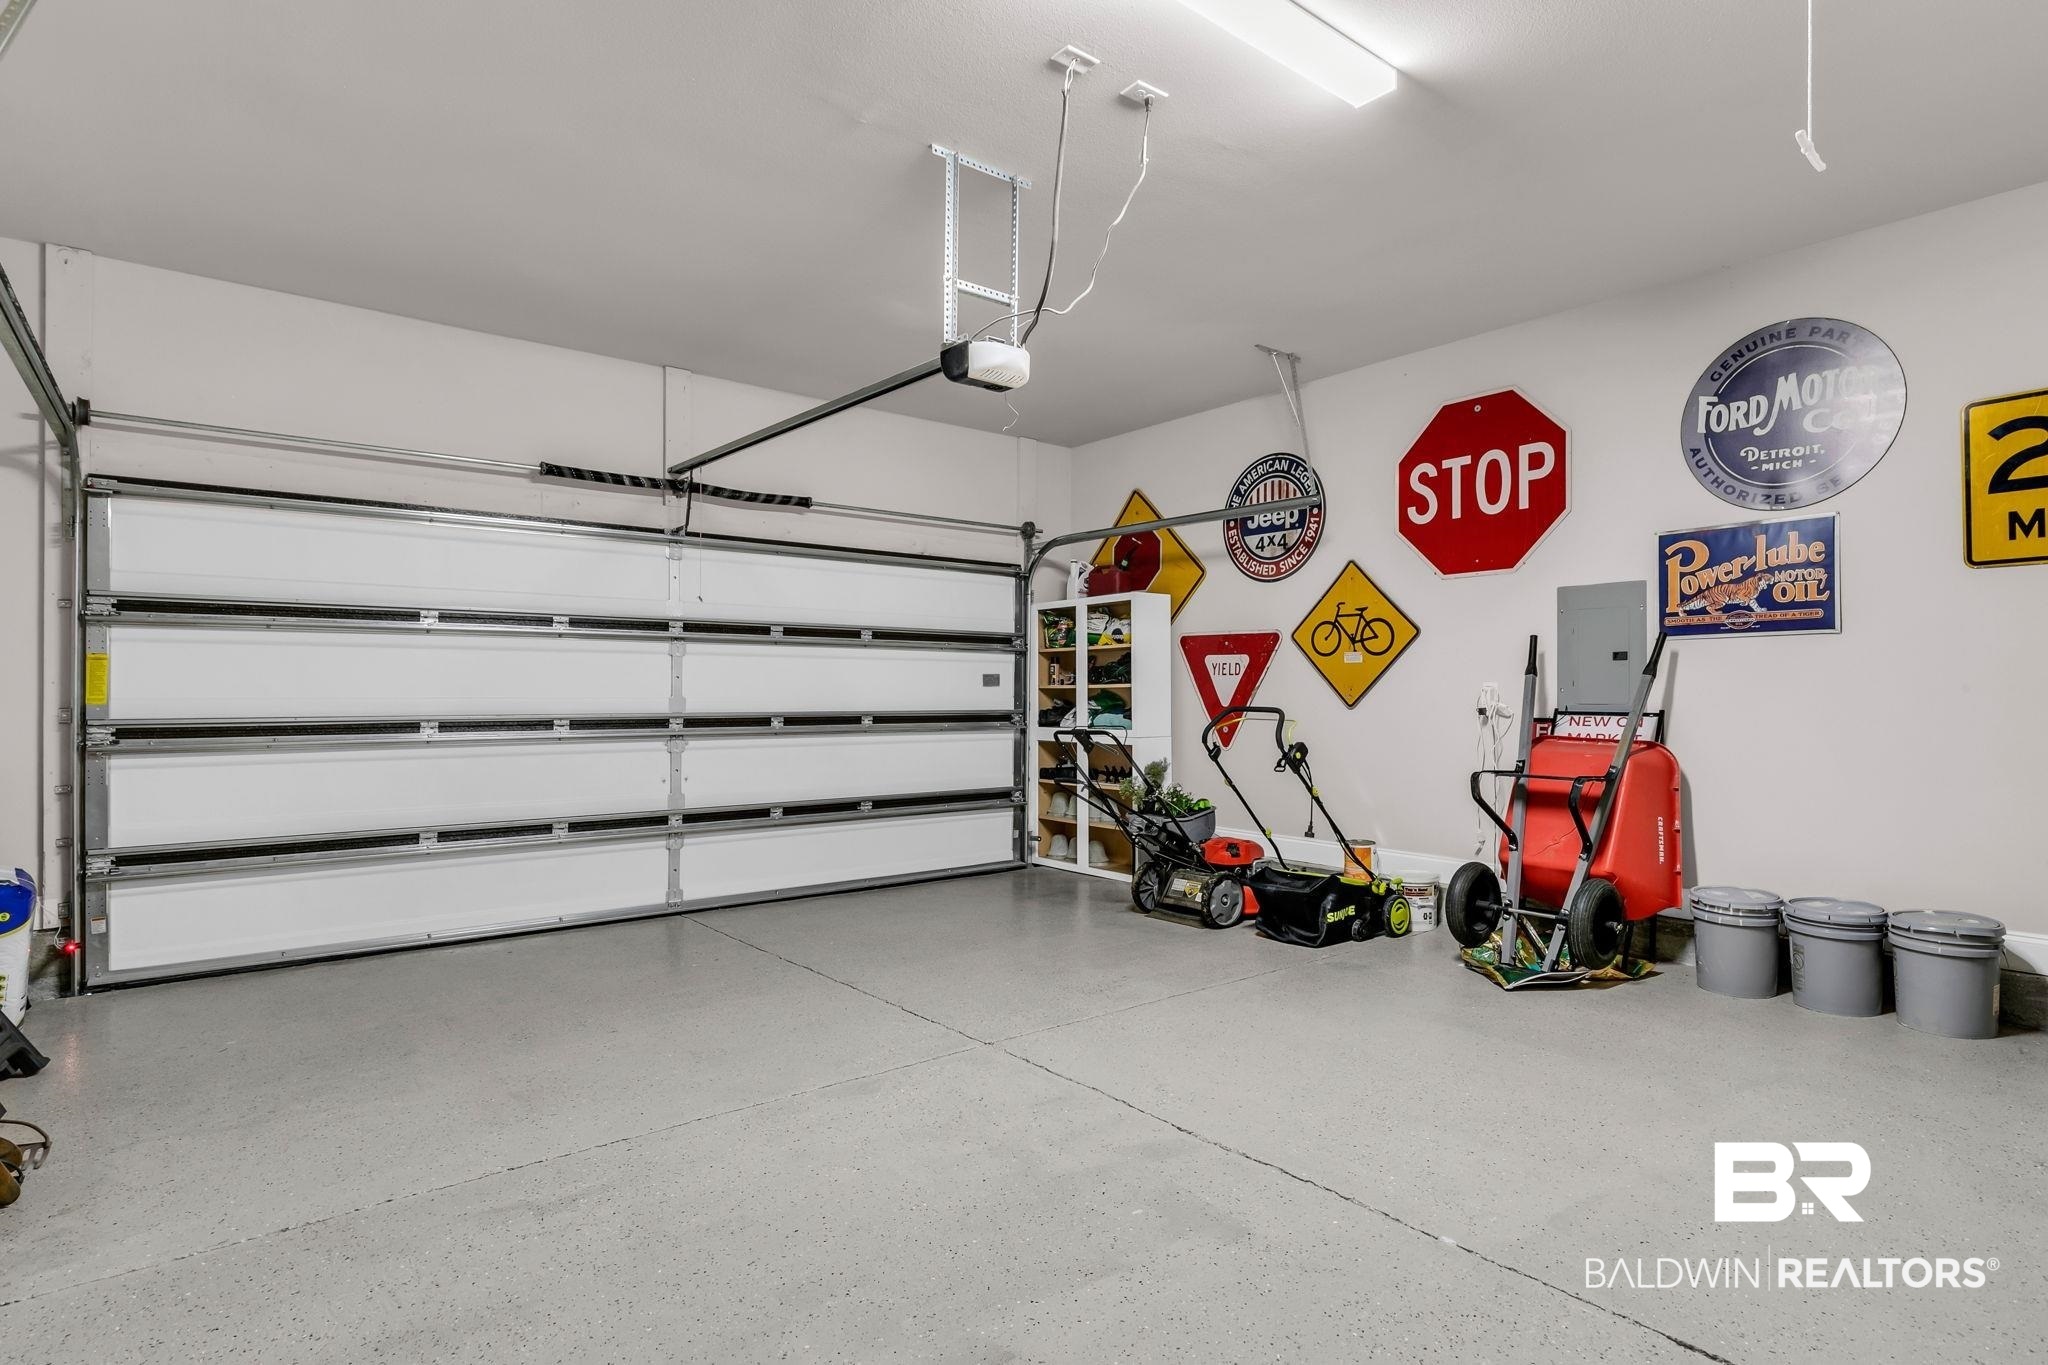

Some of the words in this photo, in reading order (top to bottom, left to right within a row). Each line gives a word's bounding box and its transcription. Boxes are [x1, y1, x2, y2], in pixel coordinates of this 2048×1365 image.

[1710, 327, 1797, 383] GENUINE
[1987, 415, 2048, 495] 2
[1230, 494, 1242, 509] HE
[1239, 459, 1290, 495] AMERICAN
[1290, 462, 1314, 493] LEGE
[1407, 441, 1555, 525] STOP
[1689, 447, 1804, 505] AUTHORIZED
[1247, 510, 1299, 529] Jeep
[1228, 528, 1277, 576] ESTABLISHED
[1279, 544, 1309, 573] SINCE
[1304, 516, 1320, 543] 1941
[1772, 580, 1831, 603] OIL
[1773, 567, 1828, 589] MOTOR
[1211, 662, 1241, 676] YIELD
[1567, 732, 1643, 741] MARKT
[1569, 716, 1612, 727] NEW
